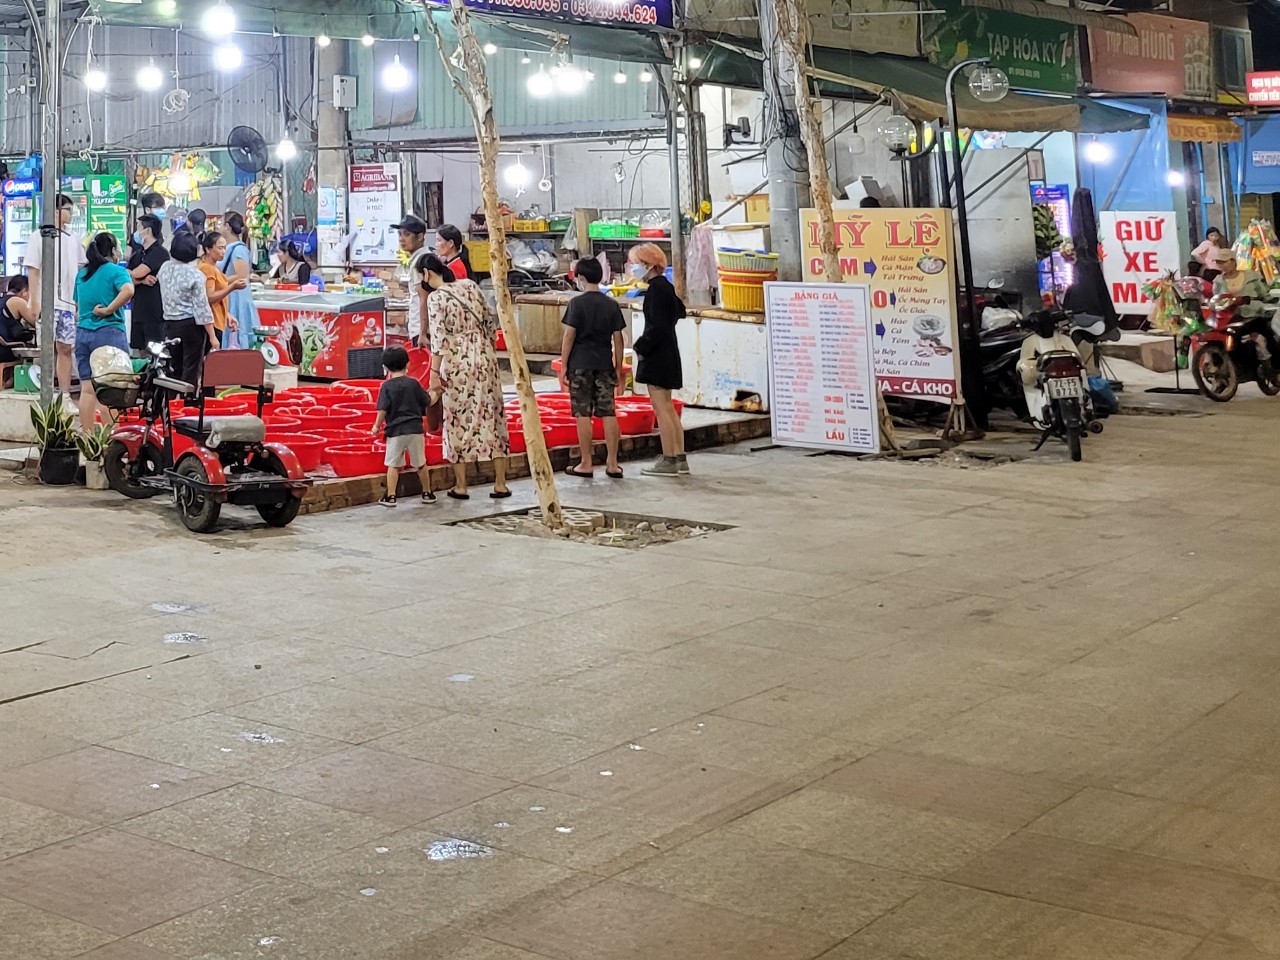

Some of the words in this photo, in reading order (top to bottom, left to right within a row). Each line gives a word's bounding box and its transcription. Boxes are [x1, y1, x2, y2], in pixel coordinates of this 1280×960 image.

[987, 32, 1010, 60] TẠP
[1013, 33, 1040, 62] HÓA
[1141, 24, 1175, 61] HÙNG
[361, 173, 394, 181] AGRIBANK
[885, 213, 941, 253] LỆ
[1115, 216, 1165, 241] GIỮ
[810, 257, 859, 276] CM
[1124, 252, 1159, 272] XE
[794, 290, 819, 300] BẢNG
[822, 291, 839, 300] GIÁ
[1112, 279, 1155, 304] MÁ
[902, 379, 921, 393] CÁ
[923, 382, 953, 395] KHO
